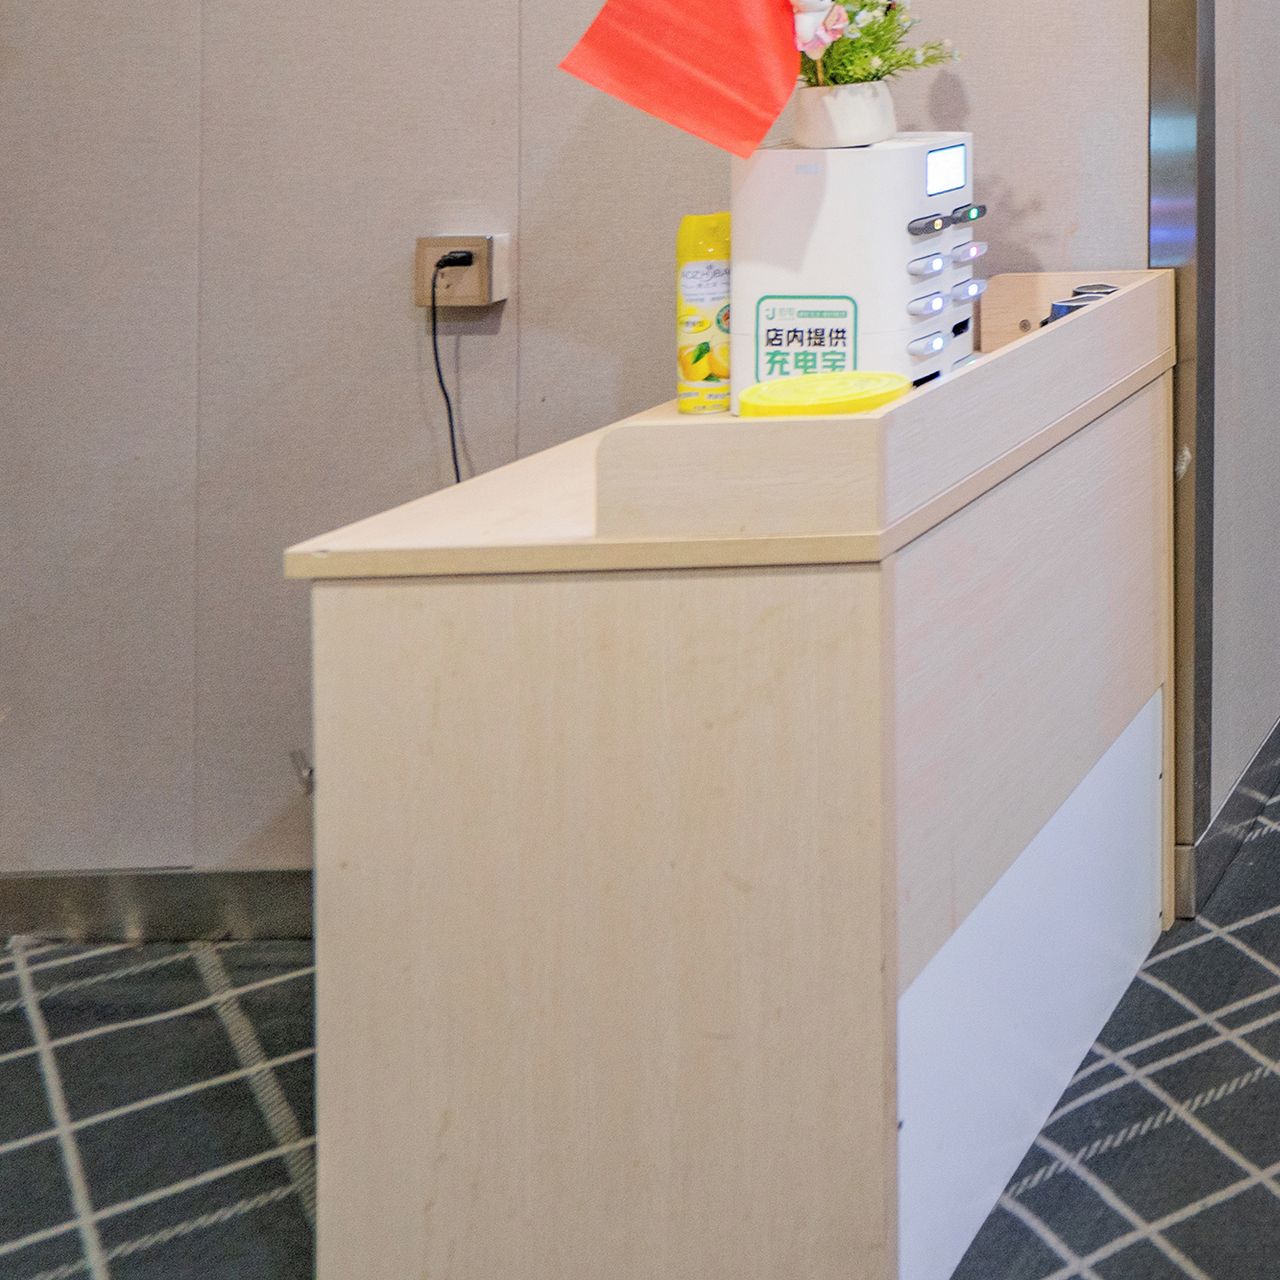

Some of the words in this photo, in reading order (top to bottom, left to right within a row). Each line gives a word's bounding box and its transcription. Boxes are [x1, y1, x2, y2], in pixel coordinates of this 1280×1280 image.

[765, 327, 847, 347] 店内提供
[765, 350, 846, 375] 充电宝
